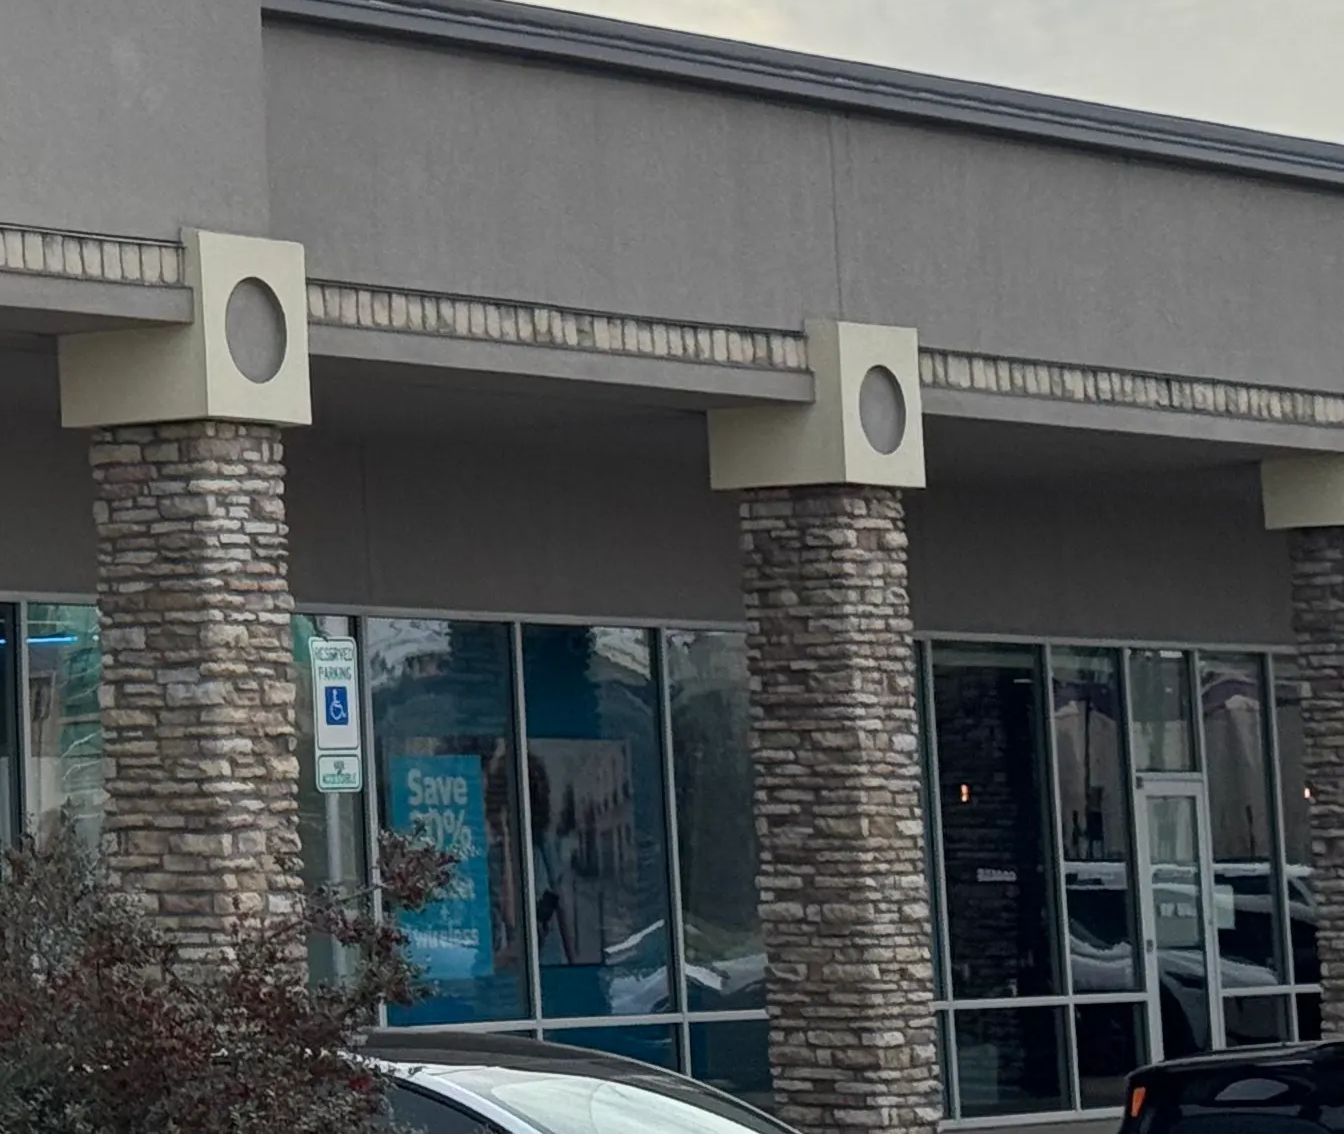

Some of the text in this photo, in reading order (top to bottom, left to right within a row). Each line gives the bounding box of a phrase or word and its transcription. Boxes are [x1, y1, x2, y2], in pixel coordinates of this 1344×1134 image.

[314, 646, 353, 662] RESERVED
[318, 666, 352, 681] PARKING
[408, 768, 467, 806] Save
